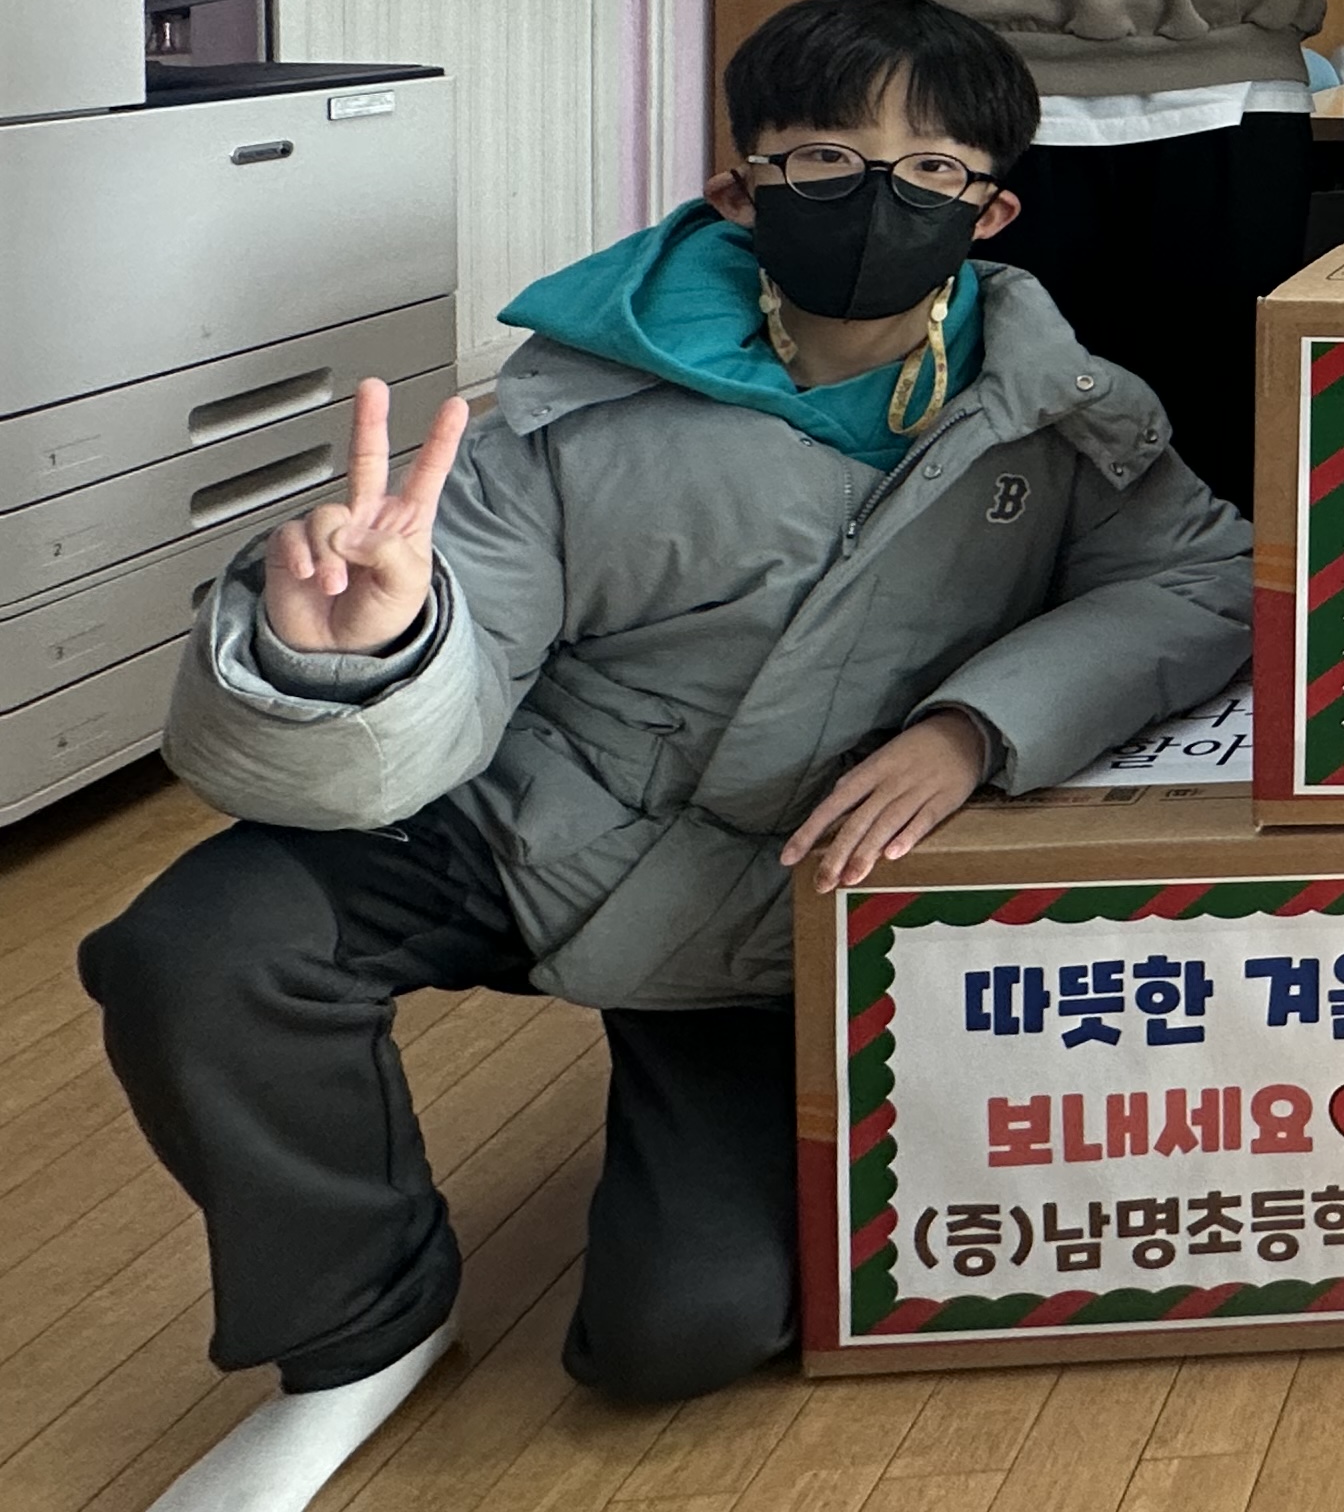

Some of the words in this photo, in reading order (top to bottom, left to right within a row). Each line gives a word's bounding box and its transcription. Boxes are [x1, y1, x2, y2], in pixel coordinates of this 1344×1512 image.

[986, 473, 1031, 523] B
[1109, 733, 1253, 769] 할아
[965, 955, 1213, 1049] 따뜻한
[988, 1085, 1313, 1167] 보내세요
